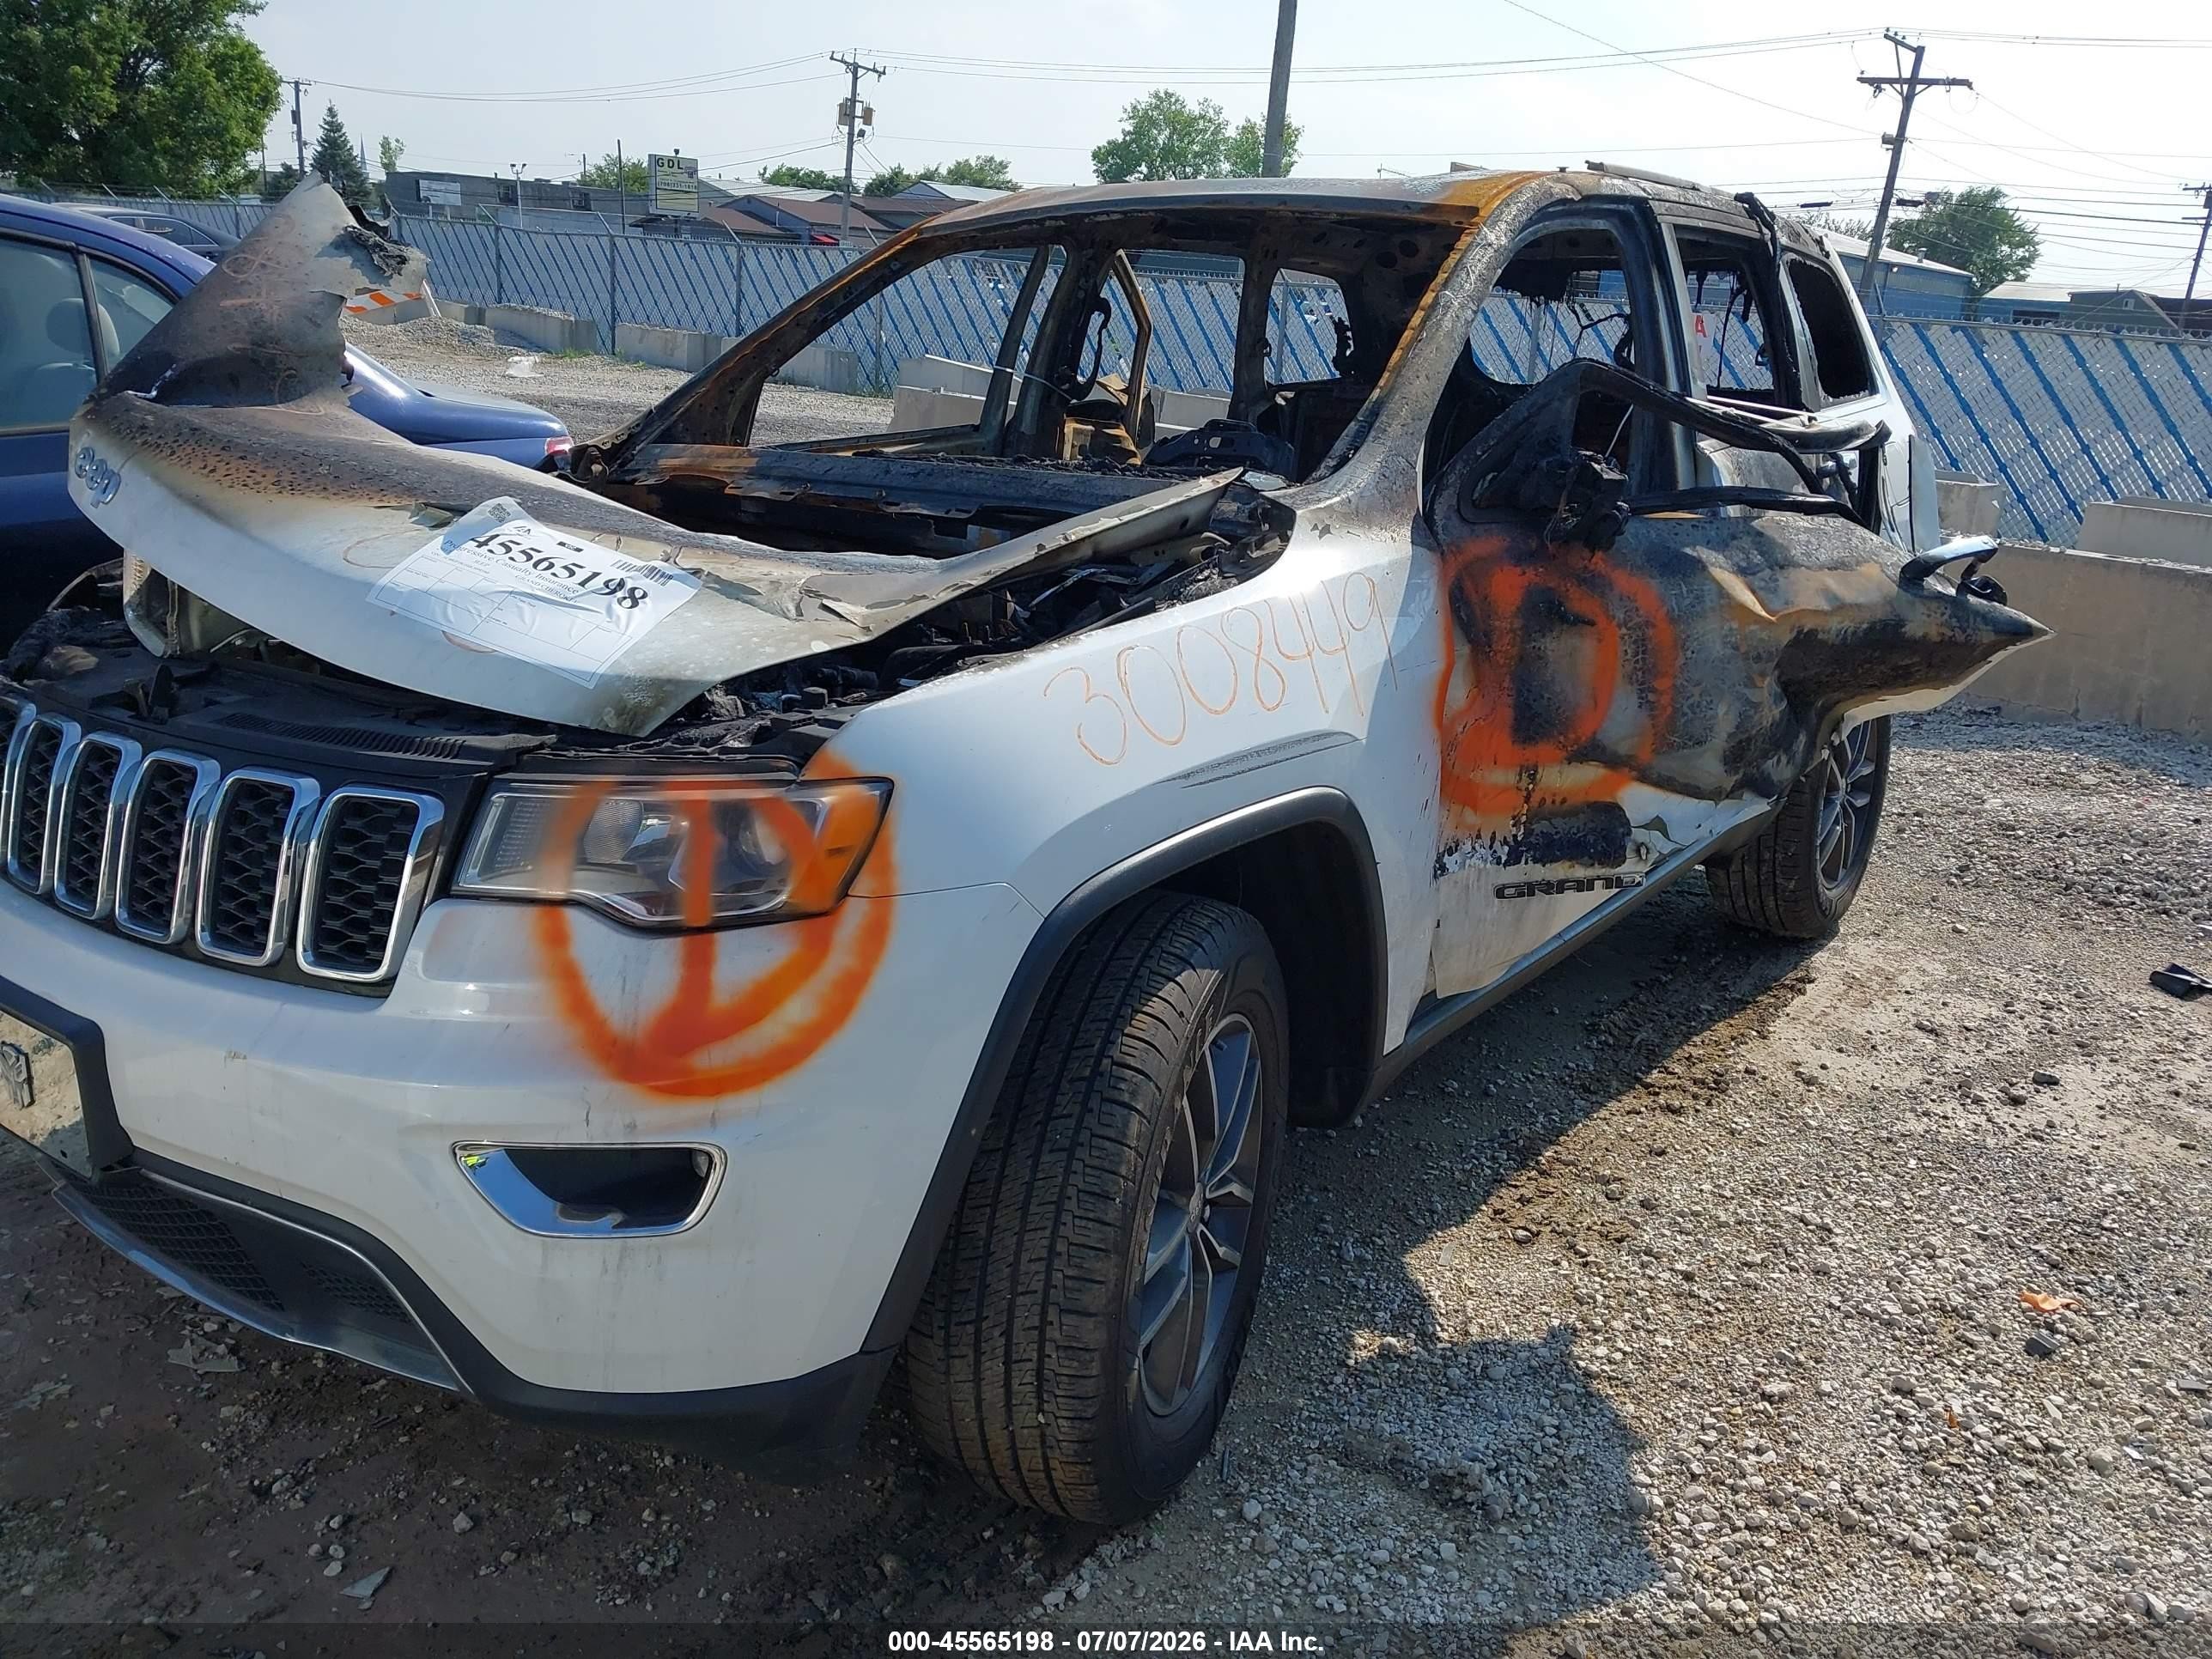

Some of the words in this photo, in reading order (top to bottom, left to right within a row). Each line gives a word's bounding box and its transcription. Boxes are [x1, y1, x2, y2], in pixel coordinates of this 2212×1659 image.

[656, 157, 684, 170] GDL
[444, 539, 495, 562] Progressive
[495, 557, 532, 577] Casualty
[535, 572, 580, 595] Insurance
[469, 533, 649, 610] 45565198
[1043, 570, 1399, 767] 3008449
[1493, 872, 1646, 900] GRAND
